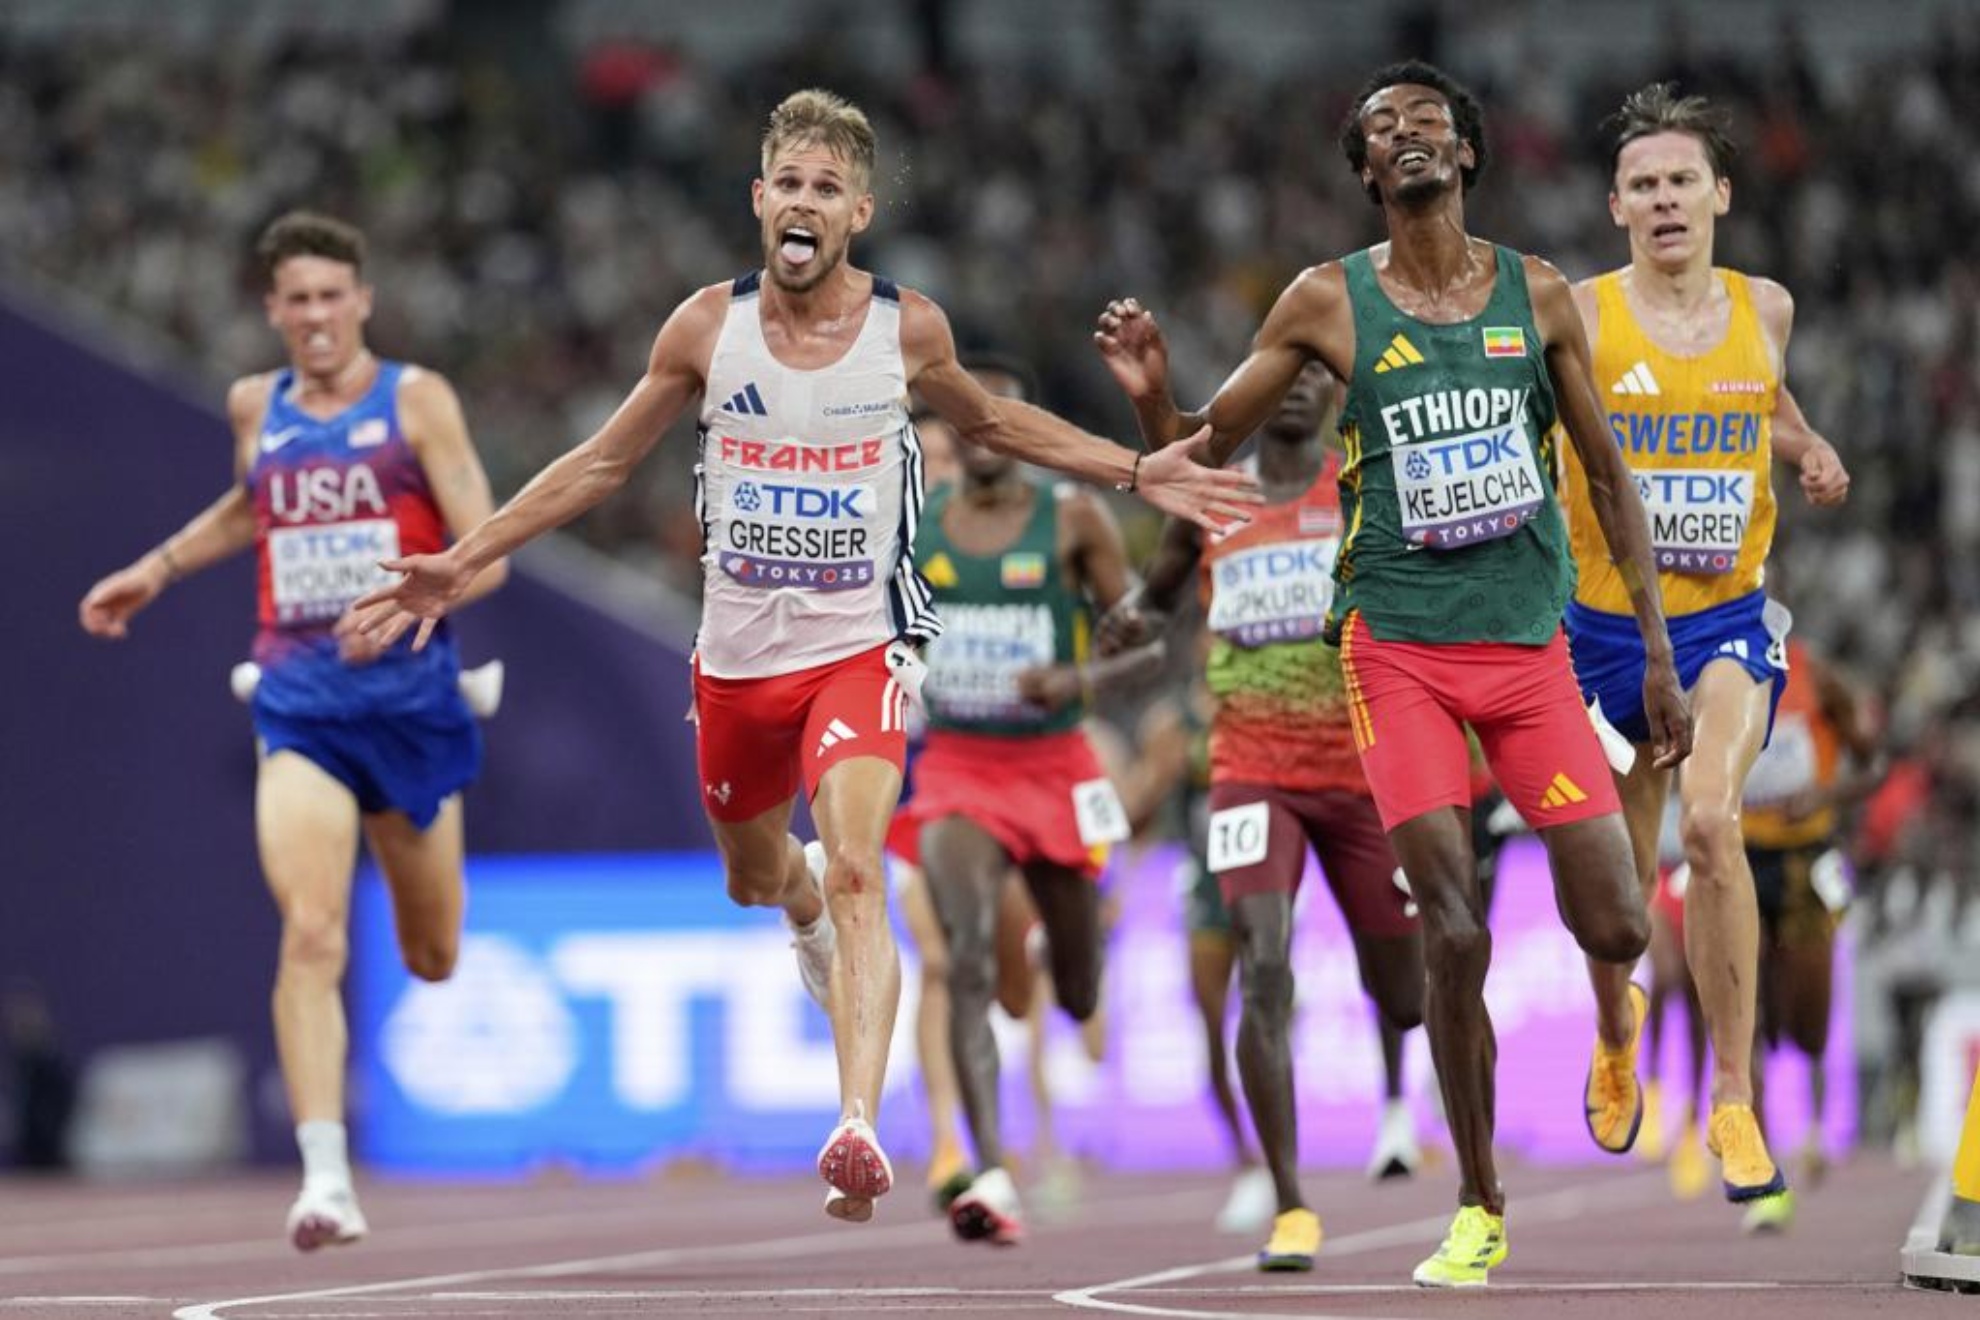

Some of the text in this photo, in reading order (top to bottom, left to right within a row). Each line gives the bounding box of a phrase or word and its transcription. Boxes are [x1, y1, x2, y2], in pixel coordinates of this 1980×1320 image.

[1429, 429, 1521, 476] TDK
[1608, 413, 1761, 455] SWEDEN
[720, 437, 883, 472] FRANCE
[270, 463, 386, 523] USA
[762, 484, 863, 519] TDK
[1405, 466, 1536, 520] KEJELCHA
[1652, 475, 1745, 504] TDK
[730, 520, 866, 559] GRESSIER
[1243, 547, 1327, 578] TDK
[1219, 819, 1260, 860] 10
